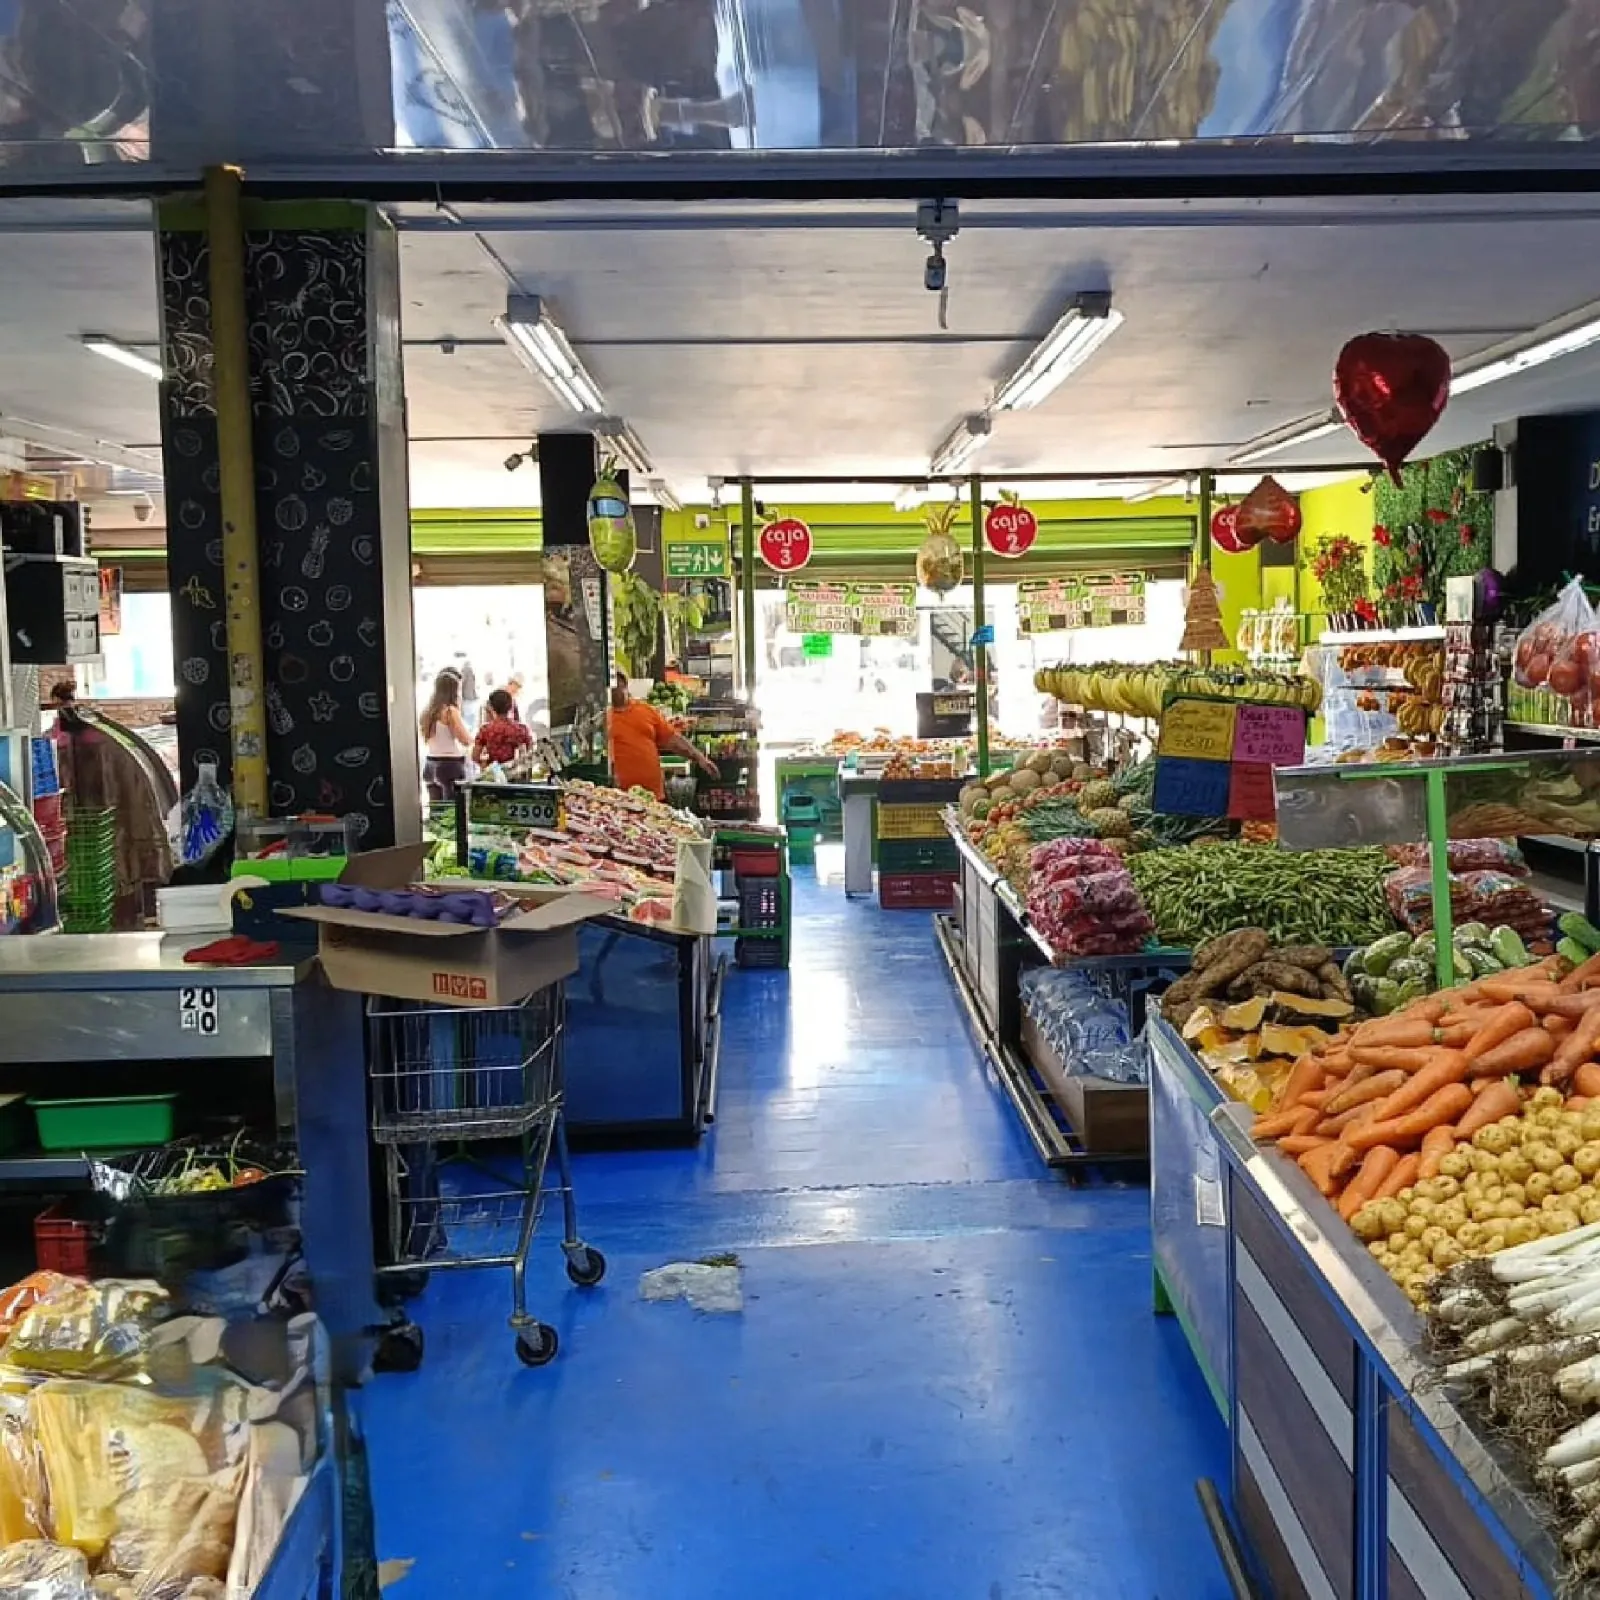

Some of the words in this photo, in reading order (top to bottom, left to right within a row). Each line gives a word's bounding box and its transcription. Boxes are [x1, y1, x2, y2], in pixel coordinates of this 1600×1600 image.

[990, 512, 1031, 532] caja
[765, 528, 805, 547] caja
[1005, 533, 1021, 552] 2
[780, 549, 792, 565] 3
[507, 804, 554, 819] 2500
[182, 986, 216, 1009] 20
